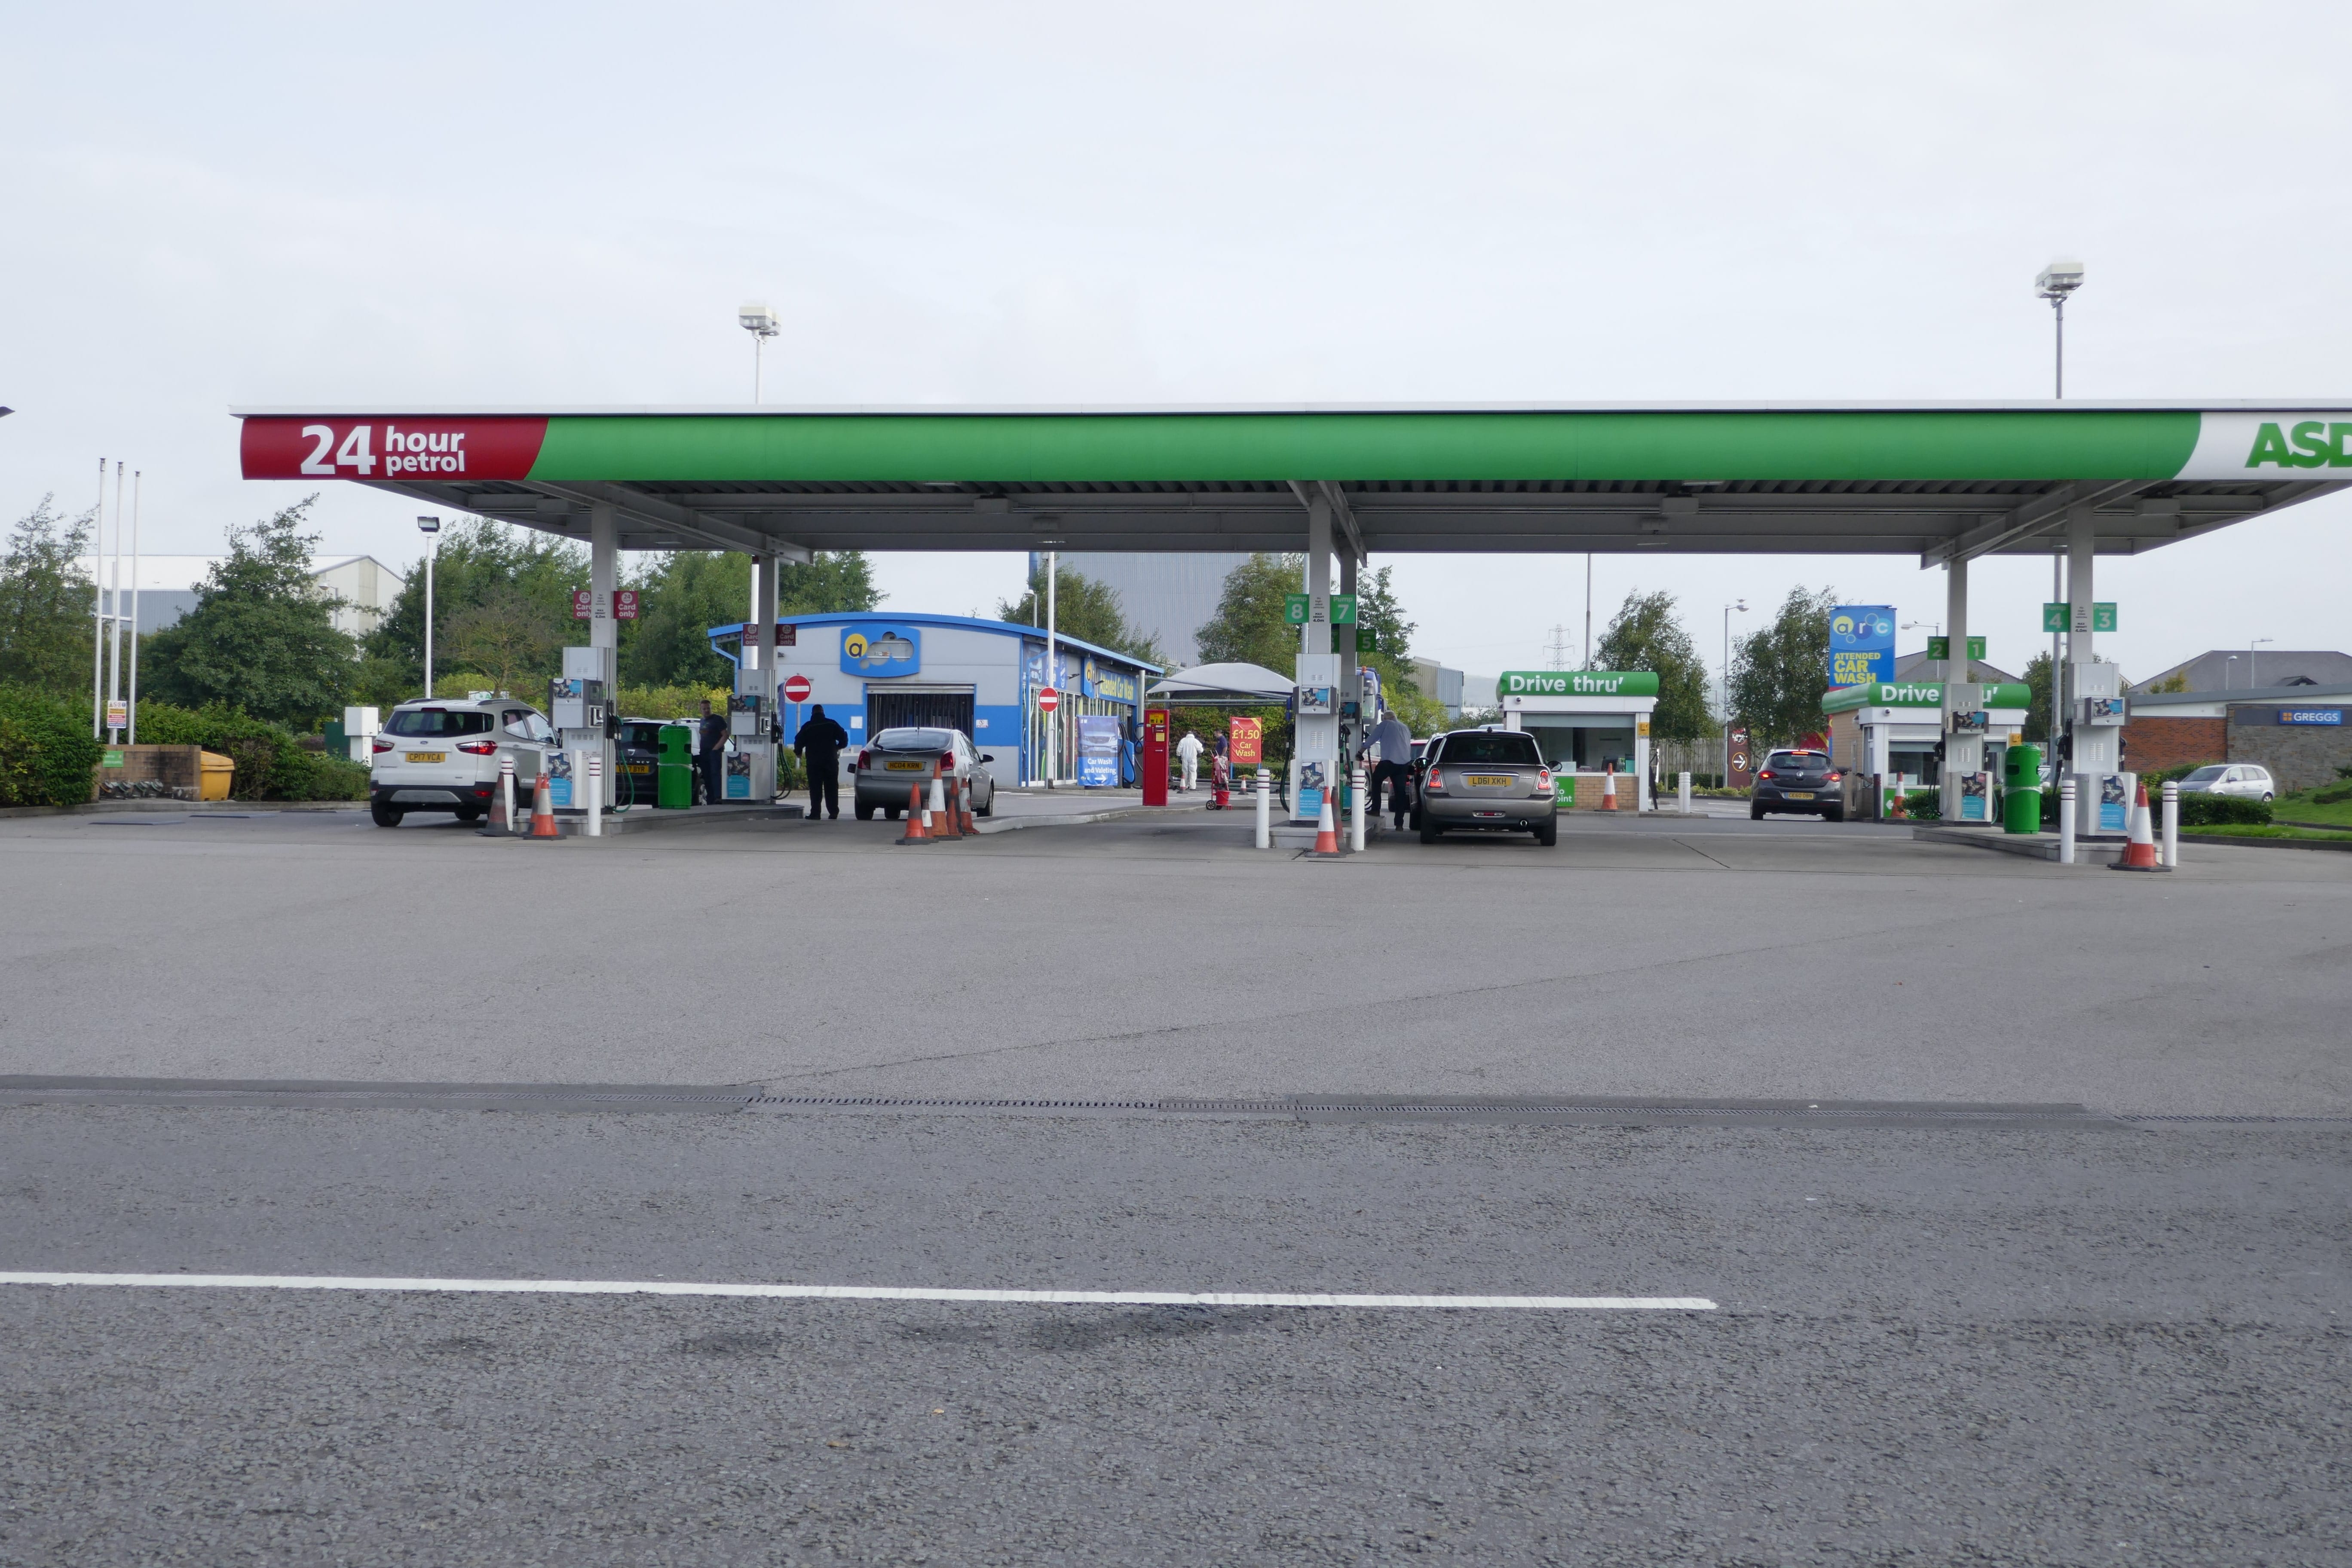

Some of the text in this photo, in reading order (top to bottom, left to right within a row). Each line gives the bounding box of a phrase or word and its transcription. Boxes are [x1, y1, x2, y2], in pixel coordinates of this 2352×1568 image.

[301, 425, 465, 475] 24 hour
[386, 450, 465, 476] petrol
[1291, 603, 1303, 619] 8
[1338, 604, 1349, 619] 7
[2049, 613, 2062, 628] 4
[2099, 612, 2110, 628] 3
[1837, 622, 1888, 634] arc
[849, 643, 863, 657] a
[1362, 637, 1371, 649] 5
[1932, 644, 1942, 657] 2
[1972, 644, 1980, 657] 1
[1834, 660, 1868, 673] CAR
[1510, 675, 1624, 692] Drive thru'
[1834, 673, 1877, 684] WASH
[1099, 672, 1117, 697] Attended
[1124, 678, 1133, 701] Wash
[1881, 685, 1939, 701] Drive
[2294, 713, 2338, 721] GREGGS
[1232, 729, 1259, 739] £1.50
